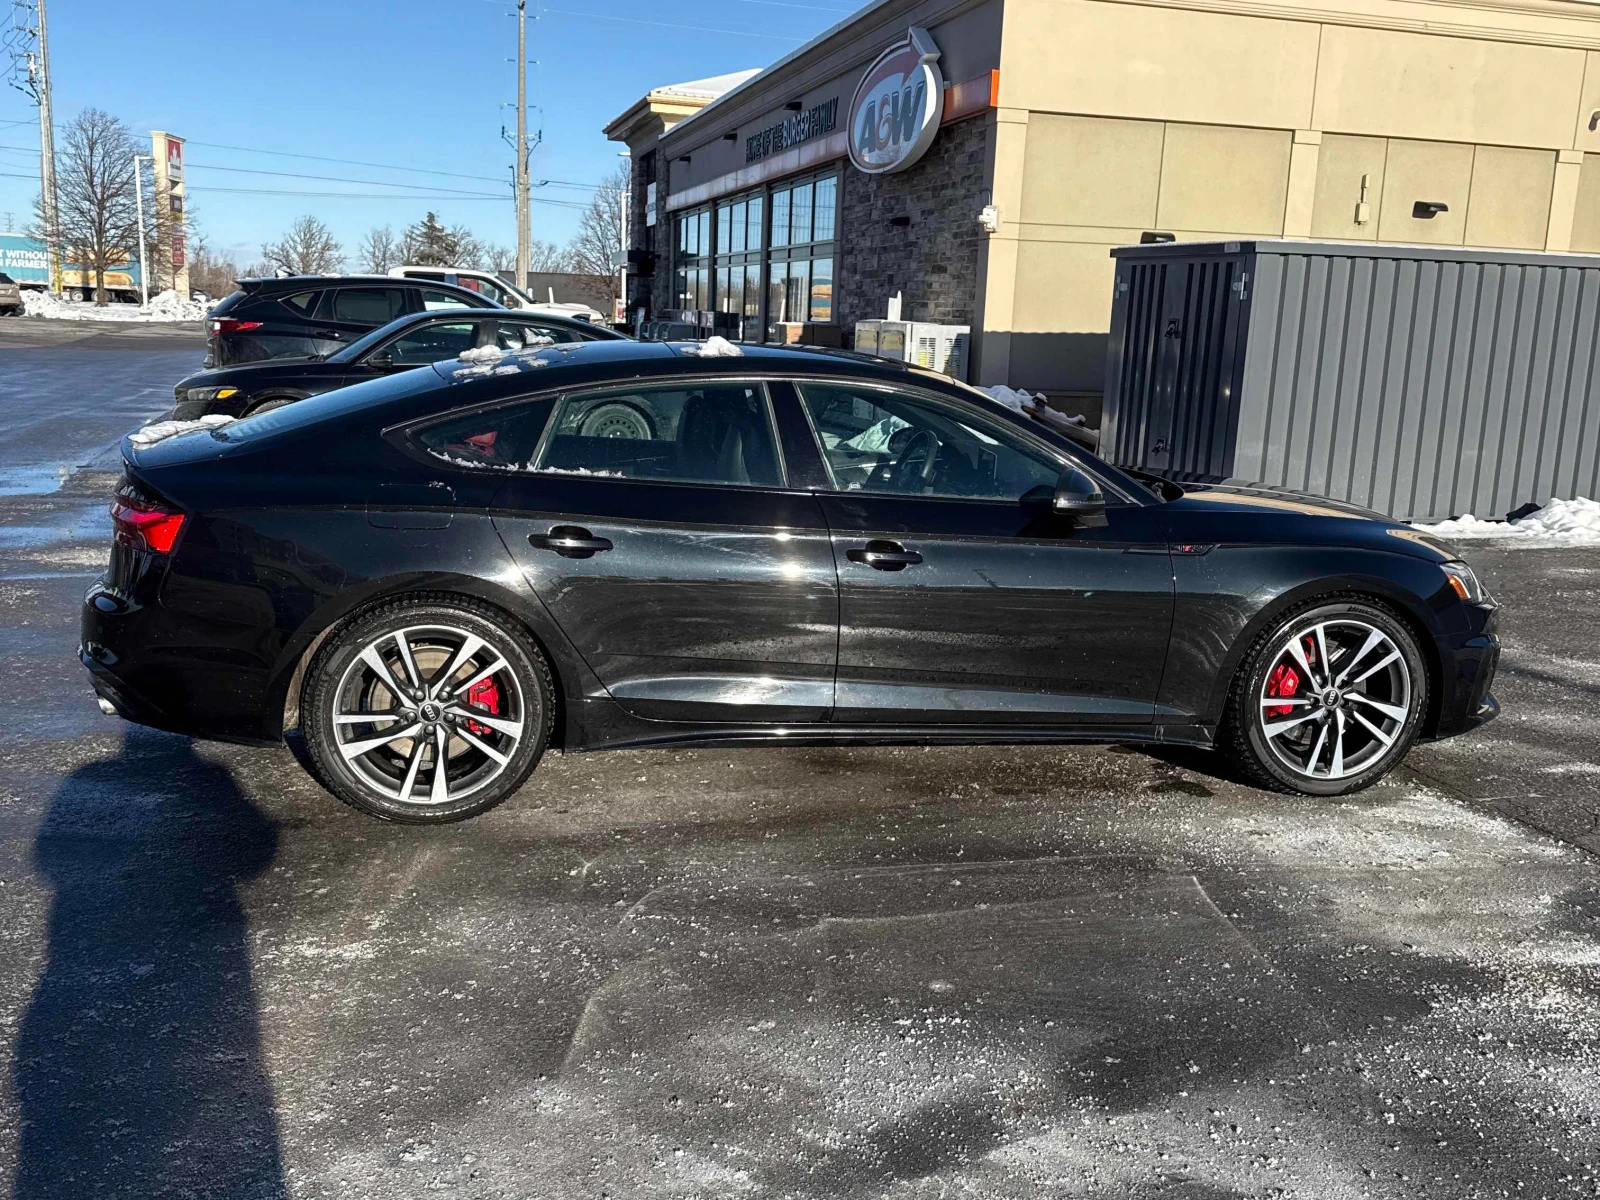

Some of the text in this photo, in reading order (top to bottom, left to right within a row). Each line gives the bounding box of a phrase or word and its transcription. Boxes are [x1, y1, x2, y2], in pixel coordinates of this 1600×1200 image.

[746, 96, 839, 163] HOME OF THE BURGER FAMILY
[858, 80, 925, 154] A&W
